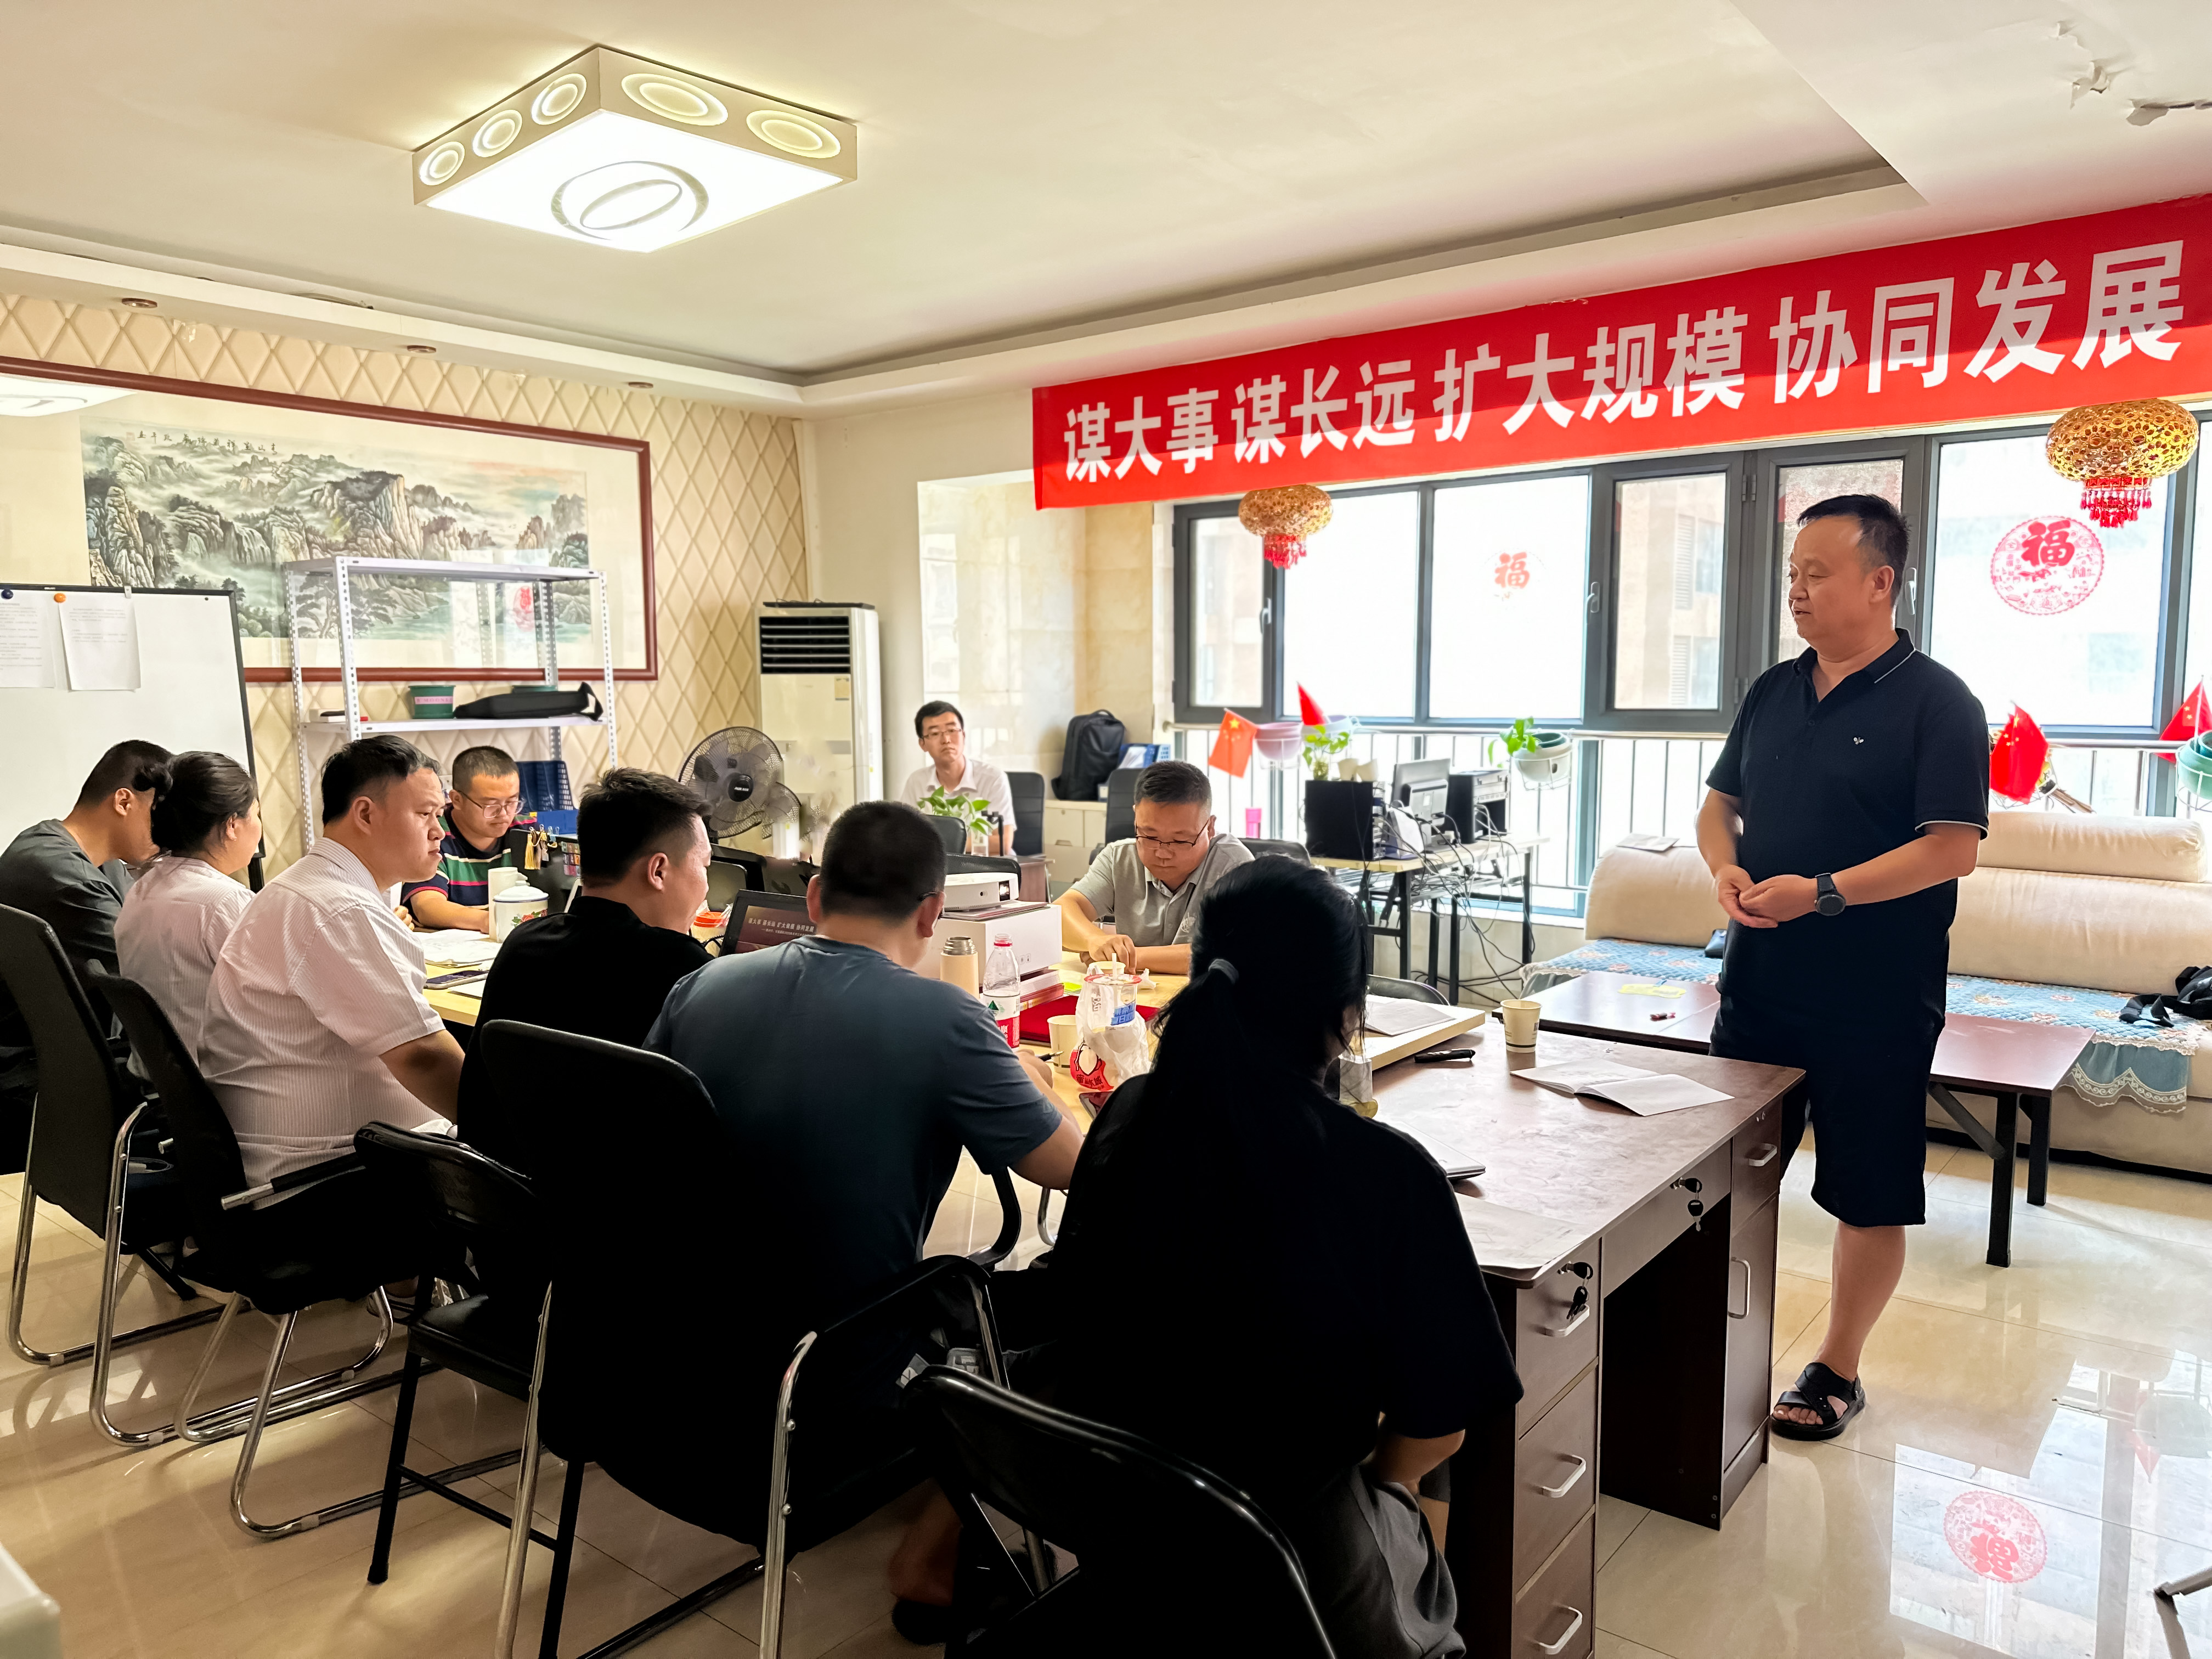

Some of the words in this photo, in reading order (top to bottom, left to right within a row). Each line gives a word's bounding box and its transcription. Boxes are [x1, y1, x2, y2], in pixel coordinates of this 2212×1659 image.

[1064, 389, 1218, 483] 谋大事
[1232, 361, 1415, 464] 谋长远
[1433, 307, 1747, 442] 扩大规模
[1770, 240, 2183, 404] 协同发展
[2021, 519, 2076, 567] 福
[1494, 551, 1530, 589] 福
